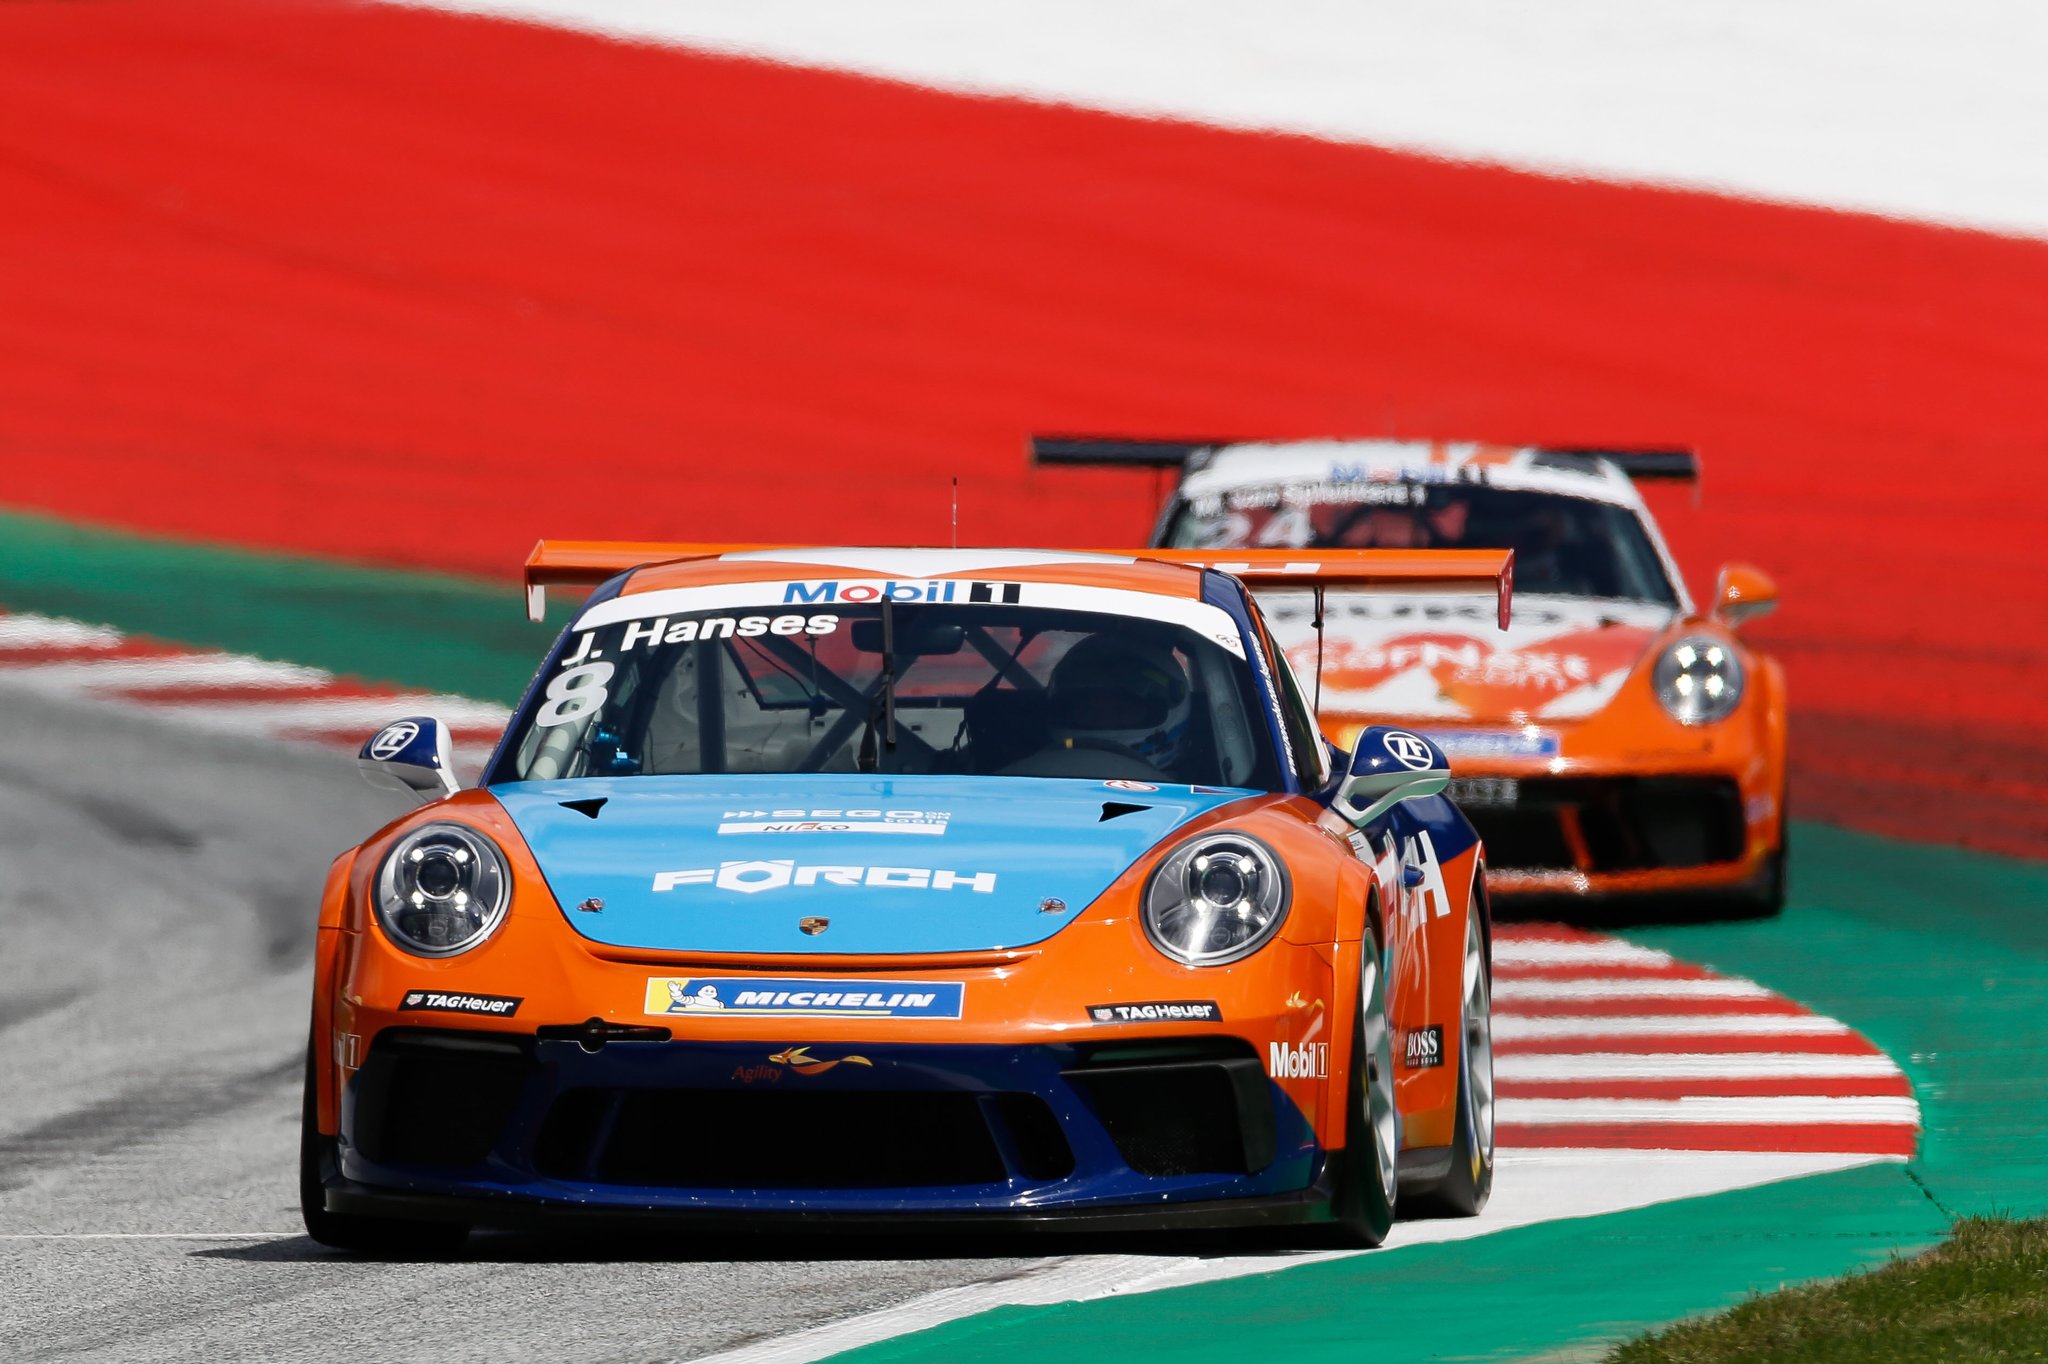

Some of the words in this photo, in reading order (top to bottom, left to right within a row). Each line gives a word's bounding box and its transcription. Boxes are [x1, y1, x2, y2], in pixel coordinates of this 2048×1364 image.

[783, 581, 956, 604] Mobil
[969, 582, 1021, 604] 1
[562, 633, 602, 666] J.
[620, 614, 840, 651] Hanses
[536, 661, 615, 727] 8
[372, 724, 418, 756] ZF
[1384, 734, 1432, 767] ZF
[771, 809, 924, 818] SEGO
[652, 859, 997, 894] FÖRCH
[734, 991, 936, 1008] MICHELIN
[1407, 1029, 1438, 1057] BOSS
[733, 1065, 783, 1083] Agility
[1269, 1041, 1316, 1078] Mobil
